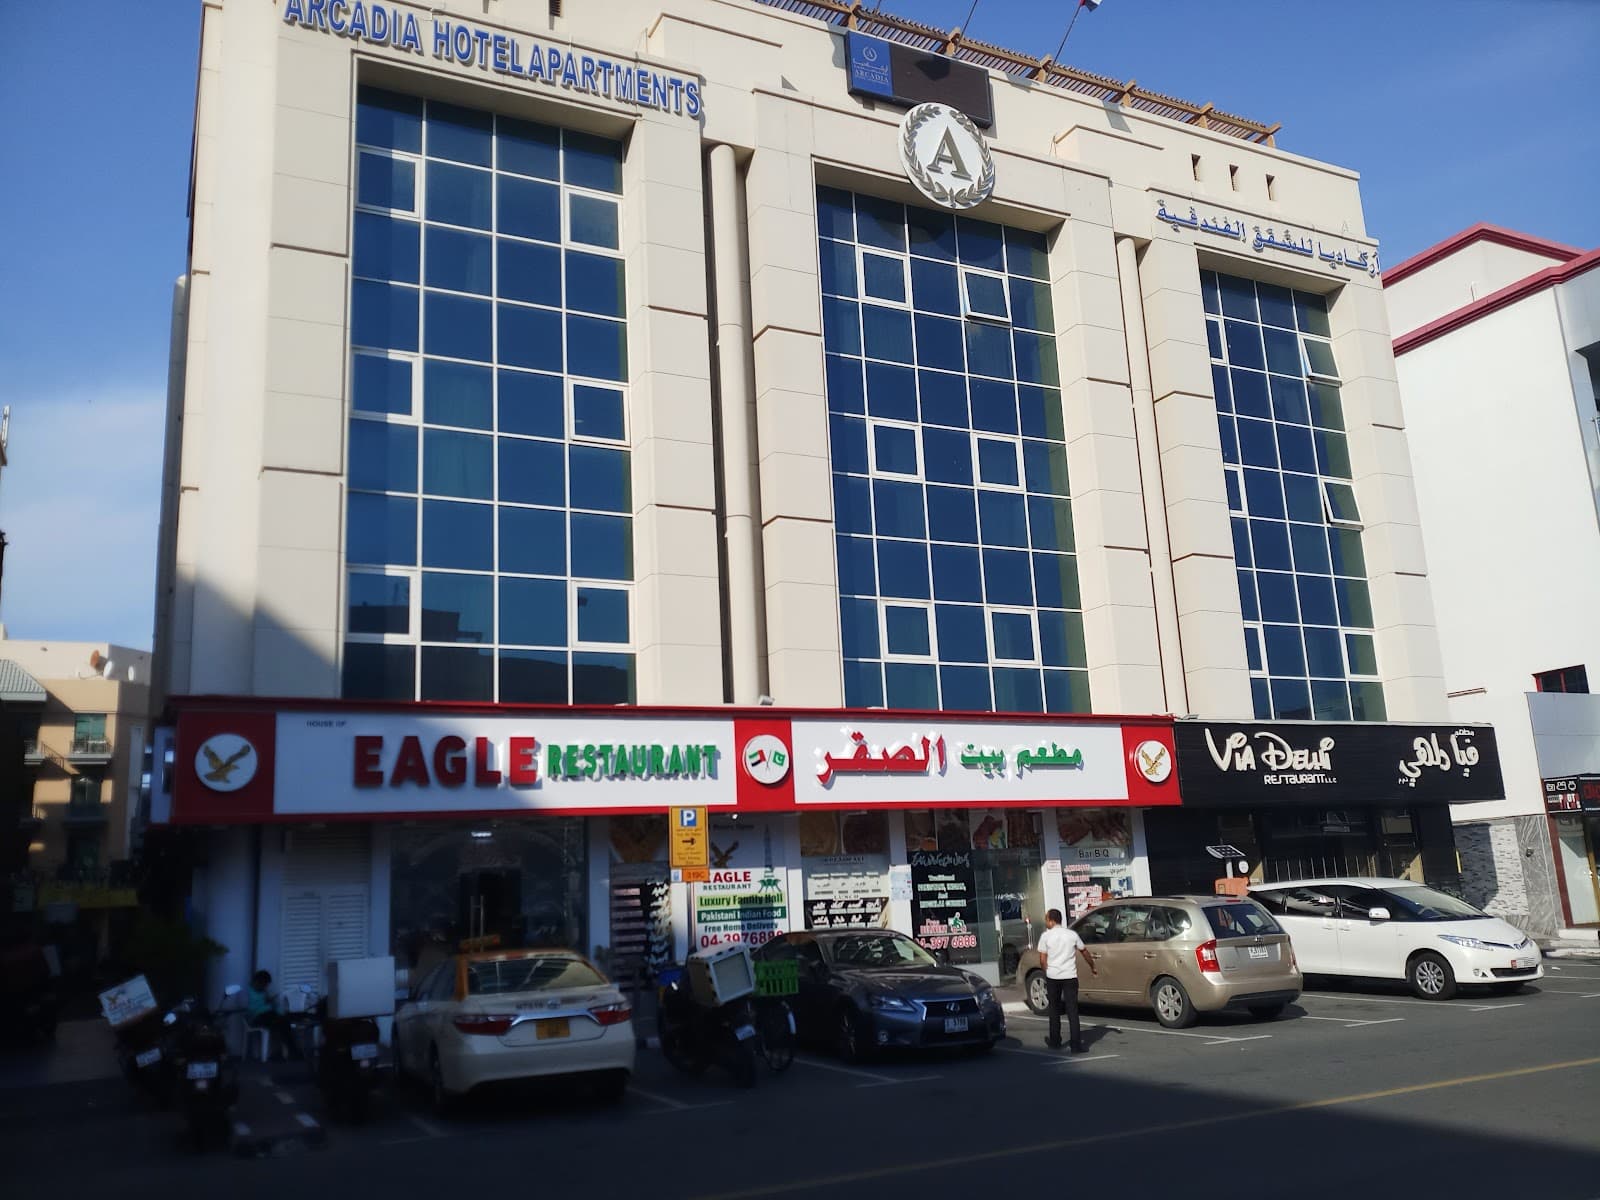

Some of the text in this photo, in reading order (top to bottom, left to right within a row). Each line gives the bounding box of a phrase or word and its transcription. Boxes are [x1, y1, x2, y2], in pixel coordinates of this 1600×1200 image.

[284, 0, 701, 117] ARCADIA HOTEL APARTMENTS
[306, 720, 334, 728] HOUSE
[354, 735, 717, 787] EAGLE RESTAURANT
[816, 731, 1082, 785] مطعم بيت الصقر
[682, 810, 695, 826] P
[704, 871, 752, 883] AGLE
[703, 883, 752, 891] RESTAURANT
[700, 896, 731, 907] Luxury
[733, 893, 762, 905] Family
[701, 908, 782, 921] Pakistani Indian Food
[704, 924, 722, 933] Free
[951, 935, 977, 948] 6888
